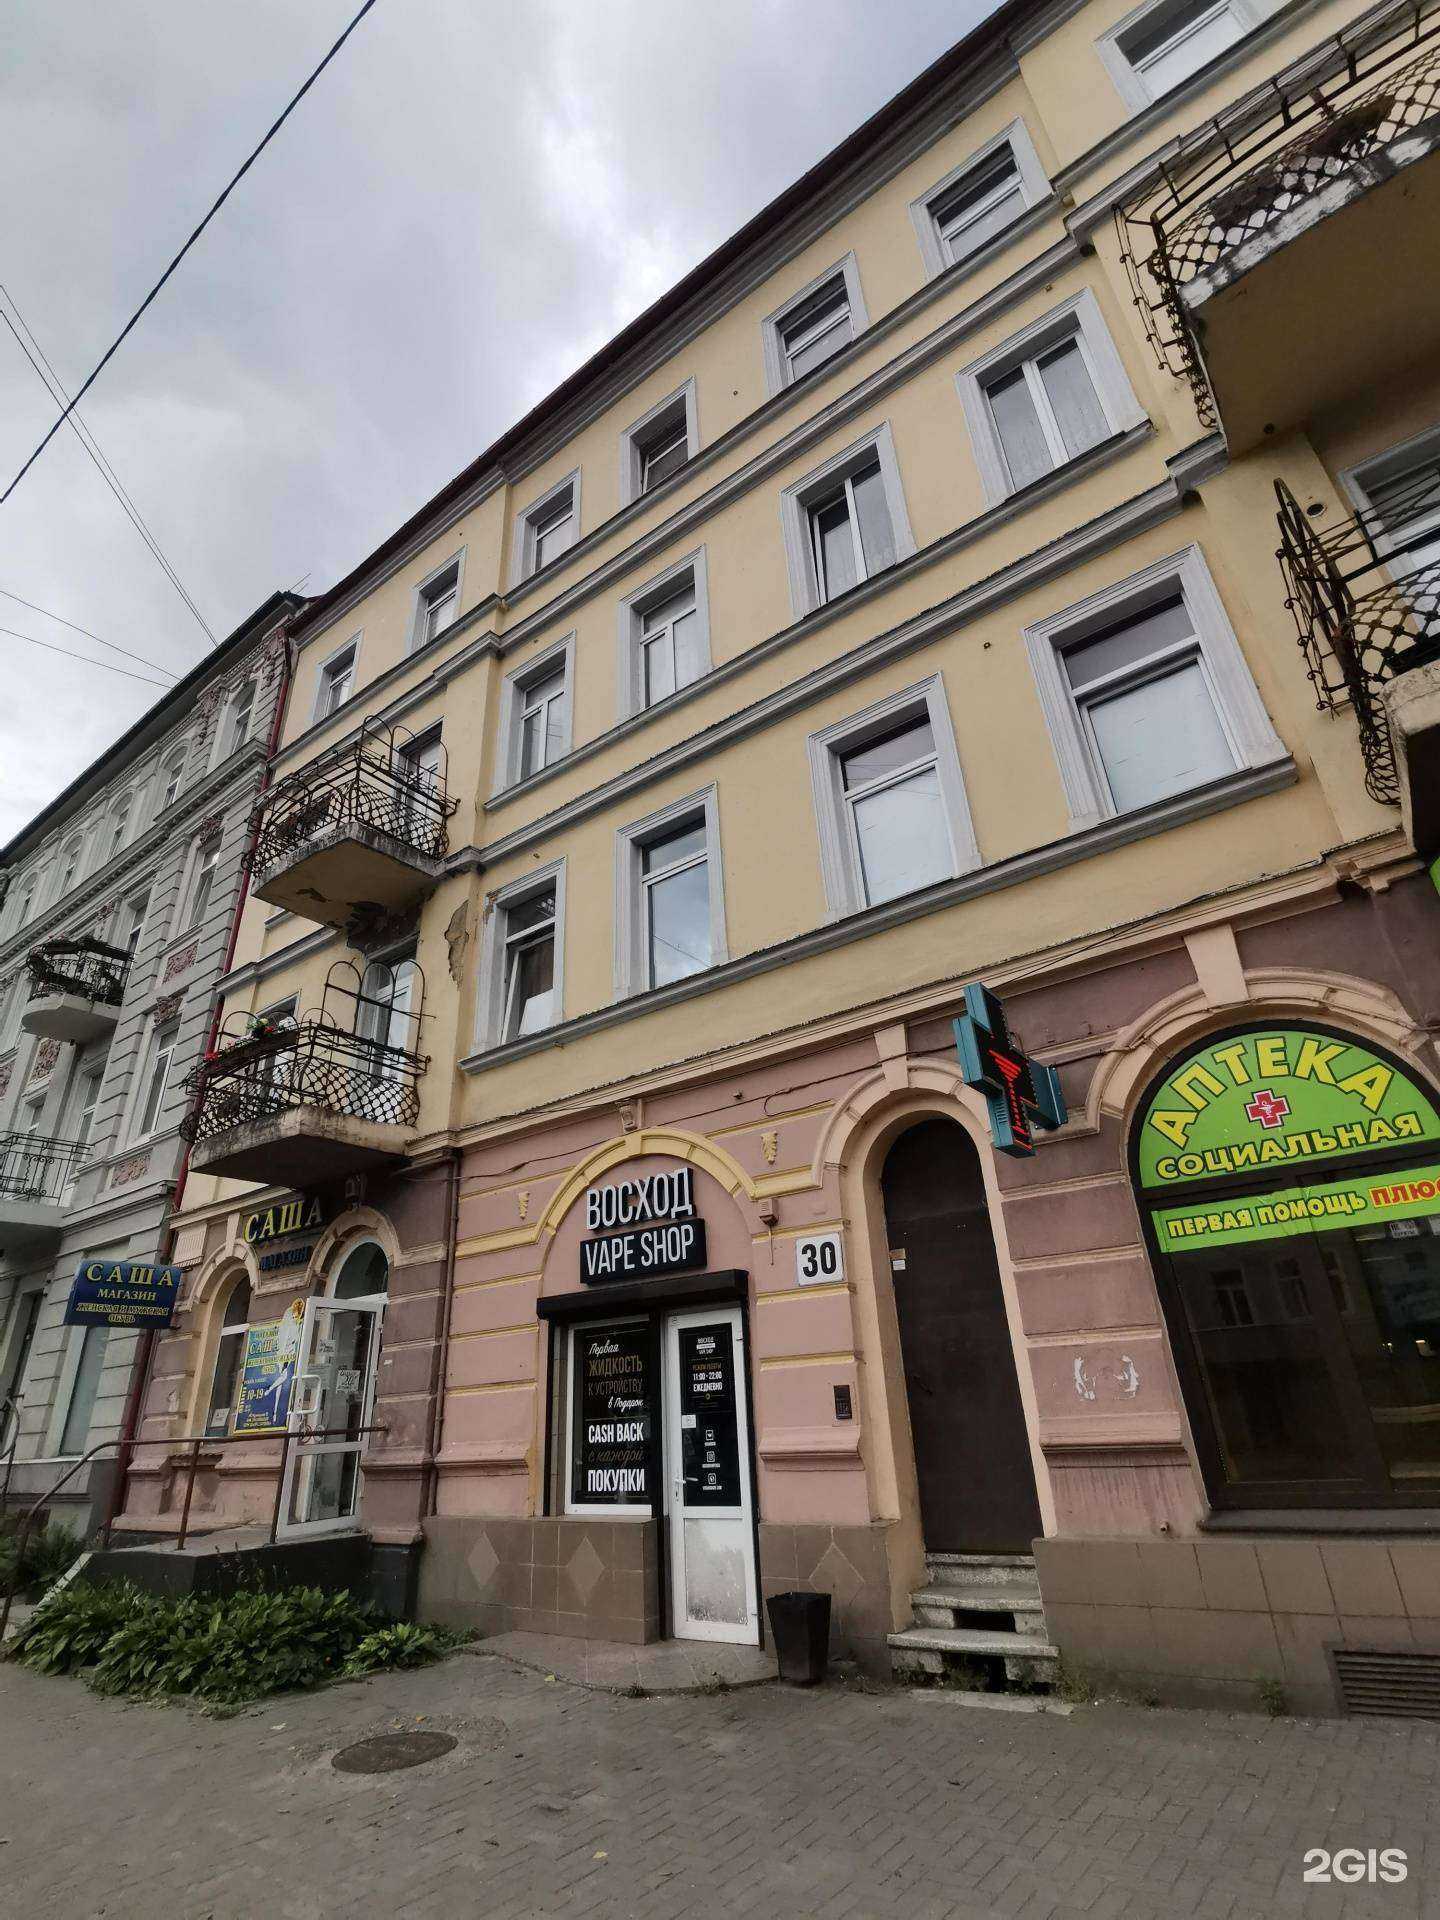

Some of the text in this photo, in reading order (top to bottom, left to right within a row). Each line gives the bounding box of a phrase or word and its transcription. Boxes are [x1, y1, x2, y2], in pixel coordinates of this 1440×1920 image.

[1150, 1036, 1395, 1150] АПТЕКА
[1156, 1112, 1424, 1180] СОЦИАЛЬНАЯ
[586, 1167, 693, 1230] ВОСХОД
[1167, 1209, 1252, 1238] ПЕРВАЯ
[1257, 1191, 1366, 1225] ПОМОЩЬ
[243, 1196, 322, 1243] САША
[585, 1224, 694, 1276] VAPE SHOP
[801, 1241, 837, 1277] 30
[86, 1263, 173, 1286] САША
[97, 1288, 157, 1301] МАГАЗИН
[588, 1354, 643, 1377] ЖИДКОСТЬ
[588, 1422, 644, 1443] CASH BACK
[587, 1468, 645, 1492] ПОКУПКИ
